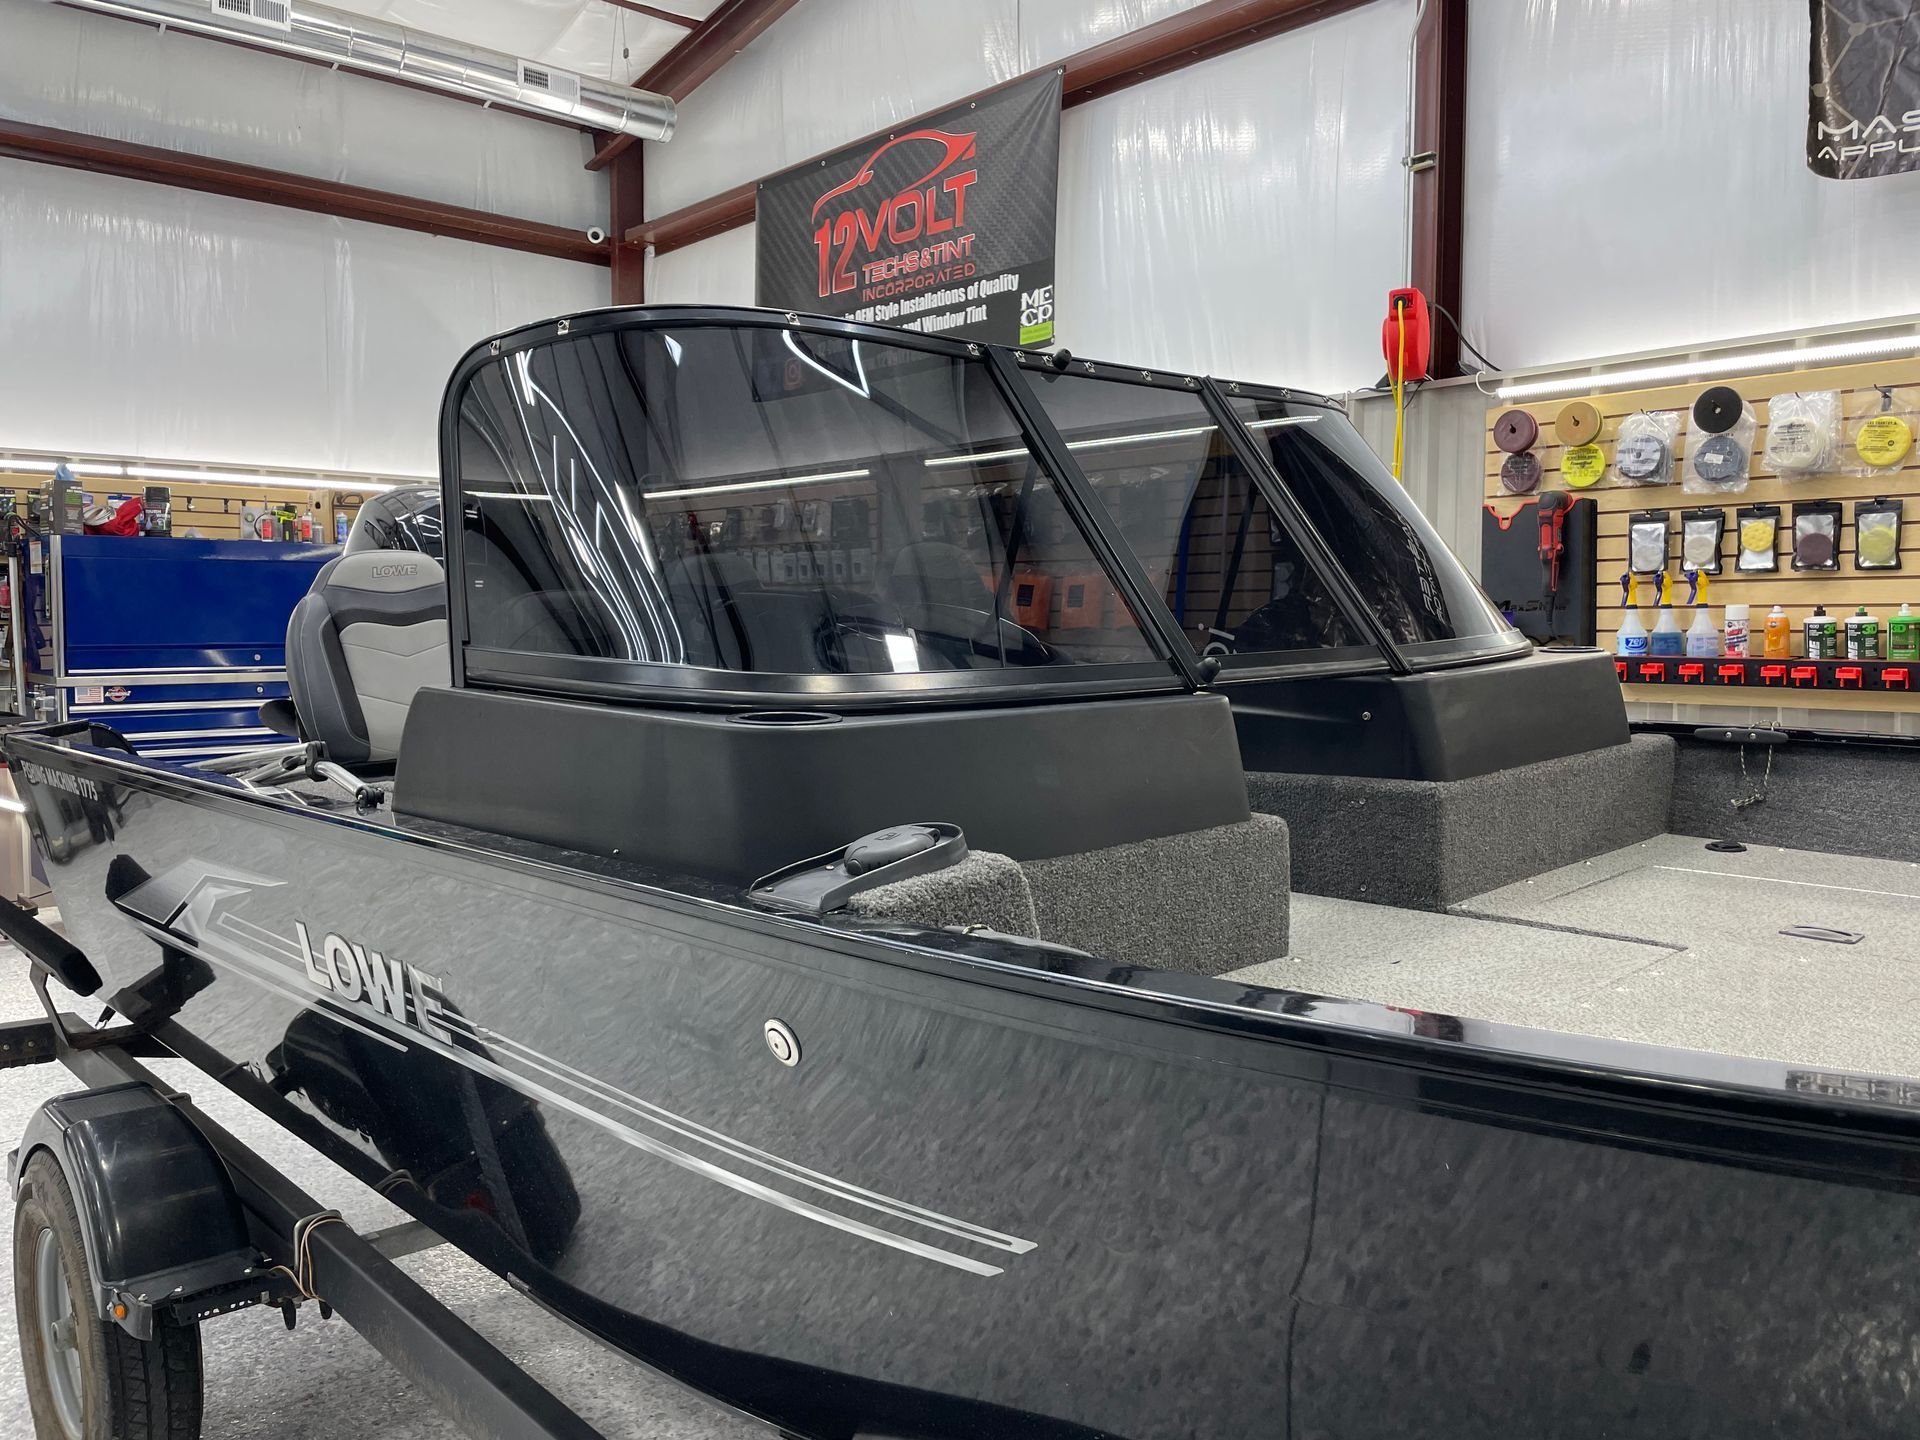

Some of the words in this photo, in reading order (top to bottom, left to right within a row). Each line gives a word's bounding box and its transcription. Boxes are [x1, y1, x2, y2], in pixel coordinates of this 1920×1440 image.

[855, 307, 874, 323] OEM
[875, 301, 899, 321] Style
[900, 286, 965, 316] Installations
[967, 282, 979, 300] of
[979, 271, 1020, 299] Quality
[861, 263, 976, 303] INCORPORATED
[921, 312, 966, 333] Window
[965, 304, 988, 326] Tint
[372, 564, 418, 579] LOWE
[1862, 624, 1878, 635] 3D
[20, 759, 48, 785] FISHING
[45, 767, 80, 795] MACHINE
[77, 776, 99, 801] 1775
[295, 918, 454, 1047] LOWE
